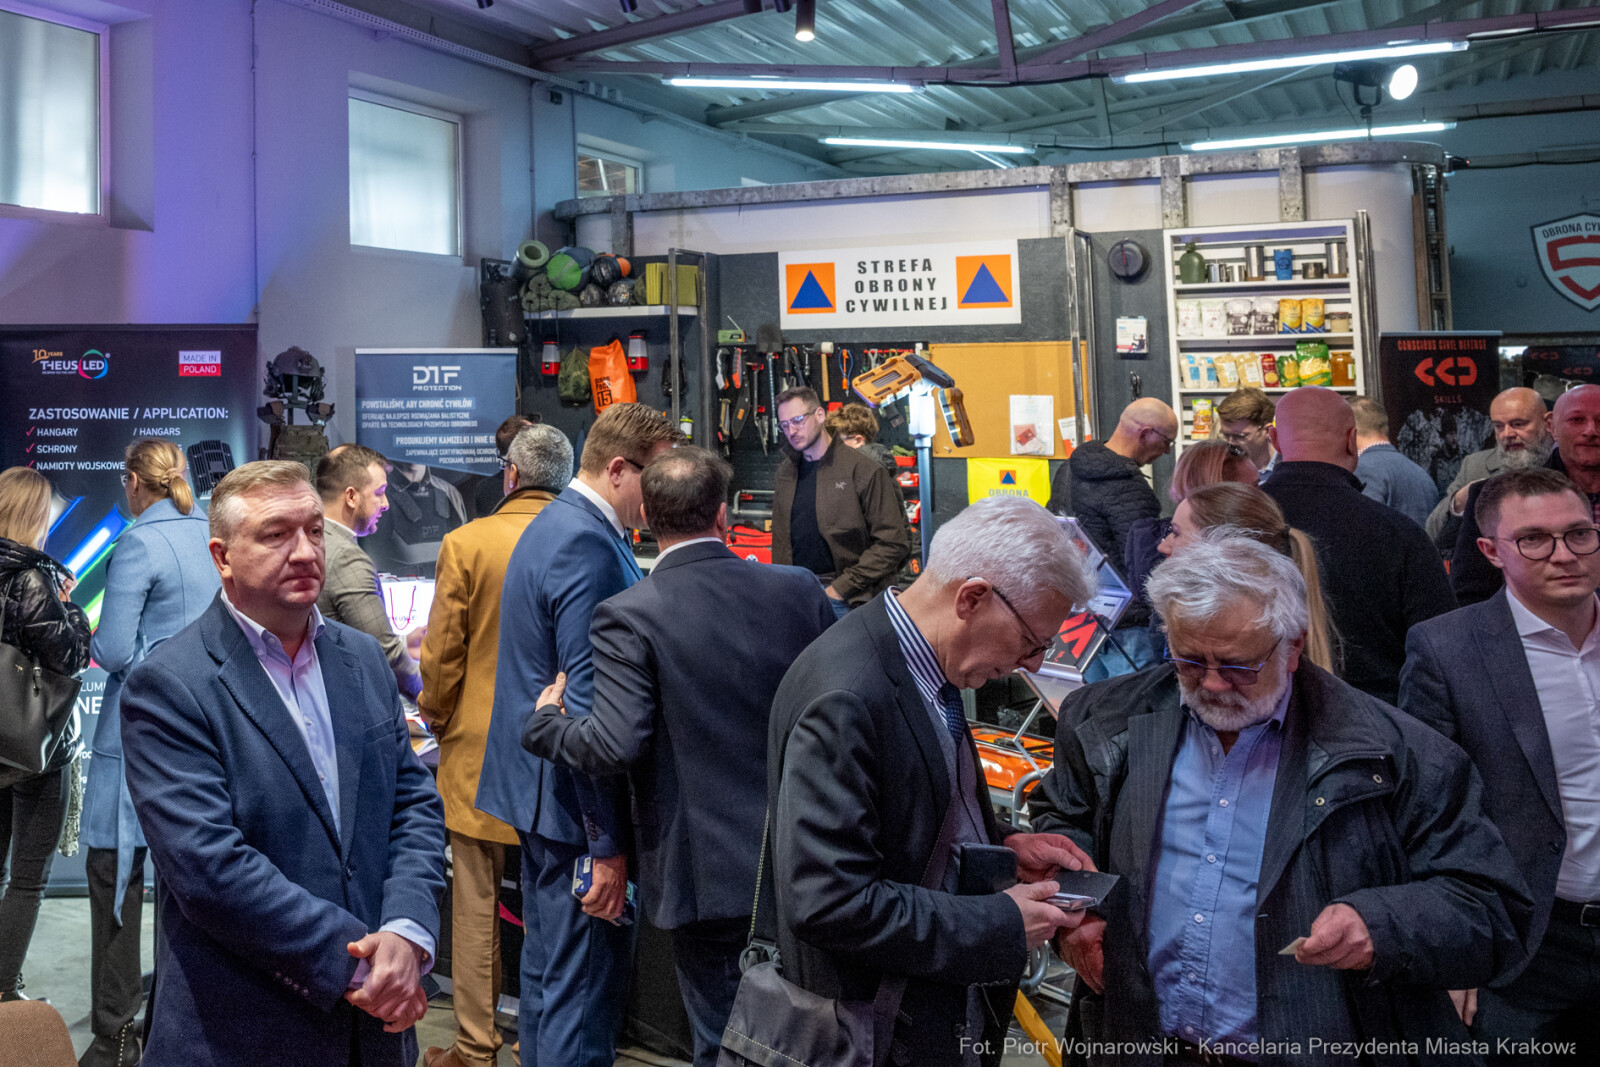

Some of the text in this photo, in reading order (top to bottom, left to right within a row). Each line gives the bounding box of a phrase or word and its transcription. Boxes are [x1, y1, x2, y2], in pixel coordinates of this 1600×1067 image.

[1542, 222, 1582, 239] OBRONA
[857, 258, 933, 275] STREFA
[854, 277, 937, 294] OBRONY
[845, 296, 948, 314] CYWILNEJ
[33, 349, 49, 360] 10
[183, 354, 217, 363] MADE IN
[40, 360, 105, 371] THEUS LED
[183, 365, 217, 374] POLAND
[413, 366, 461, 384] DTF
[406, 400, 417, 409] ABY
[1433, 395, 1462, 404] SKILLS
[29, 407, 229, 420] ZASTOSOWANIE / APPLICATION:
[37, 428, 78, 437] HANGARY
[139, 427, 181, 437] HANGARS
[439, 435, 470, 444] KAMIZELKI
[36, 445, 78, 454] SCHRONY
[36, 461, 125, 470] NAMIOTY WOJSKOWE
[988, 488, 1029, 497] OBRONA
